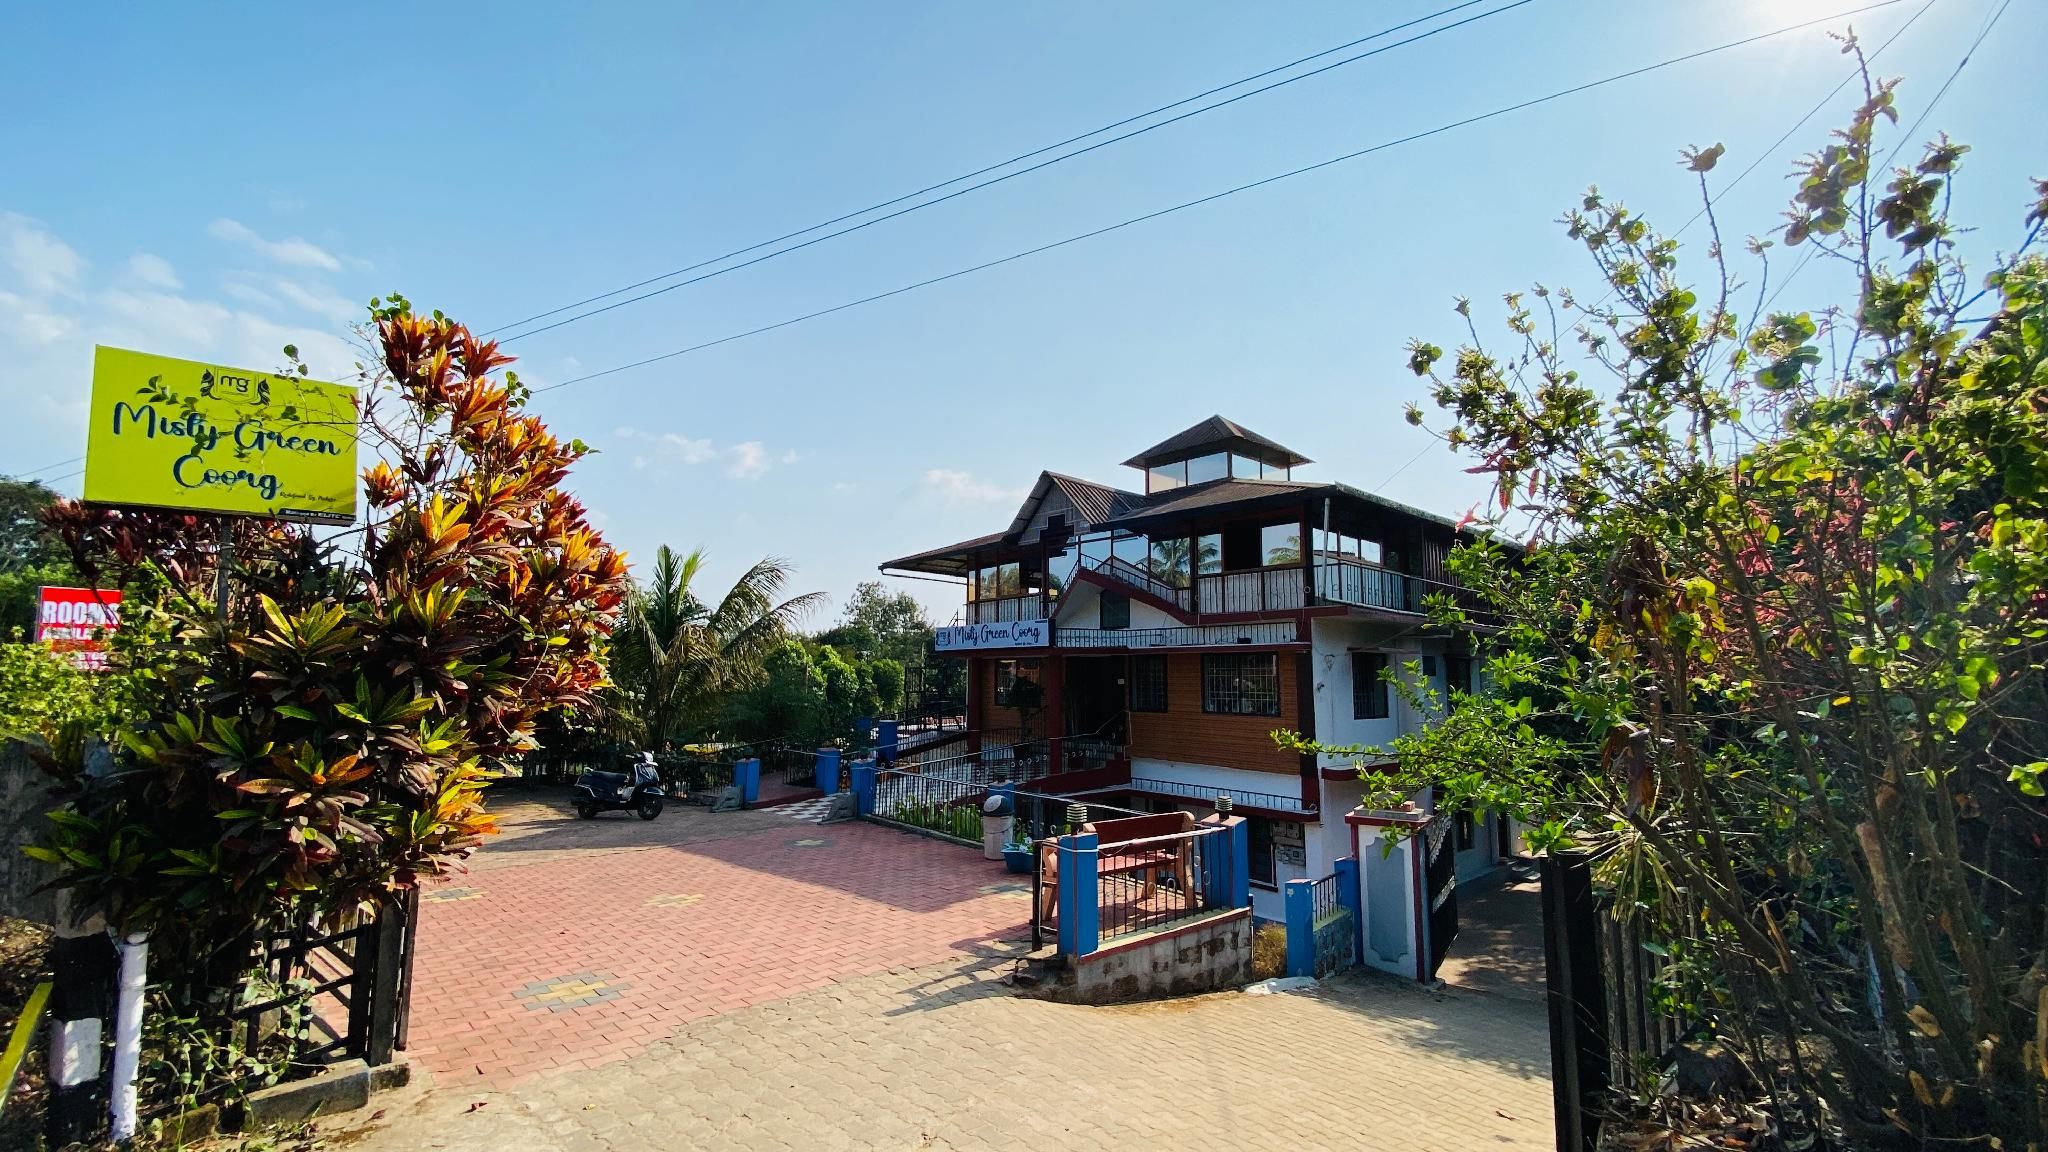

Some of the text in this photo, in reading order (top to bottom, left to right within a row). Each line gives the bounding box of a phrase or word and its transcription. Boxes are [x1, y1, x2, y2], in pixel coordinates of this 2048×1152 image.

[220, 375, 251, 393] mg
[113, 401, 341, 456] Misty Green
[173, 454, 284, 500] Coorg
[954, 621, 1040, 646] Misty Green Coorg
